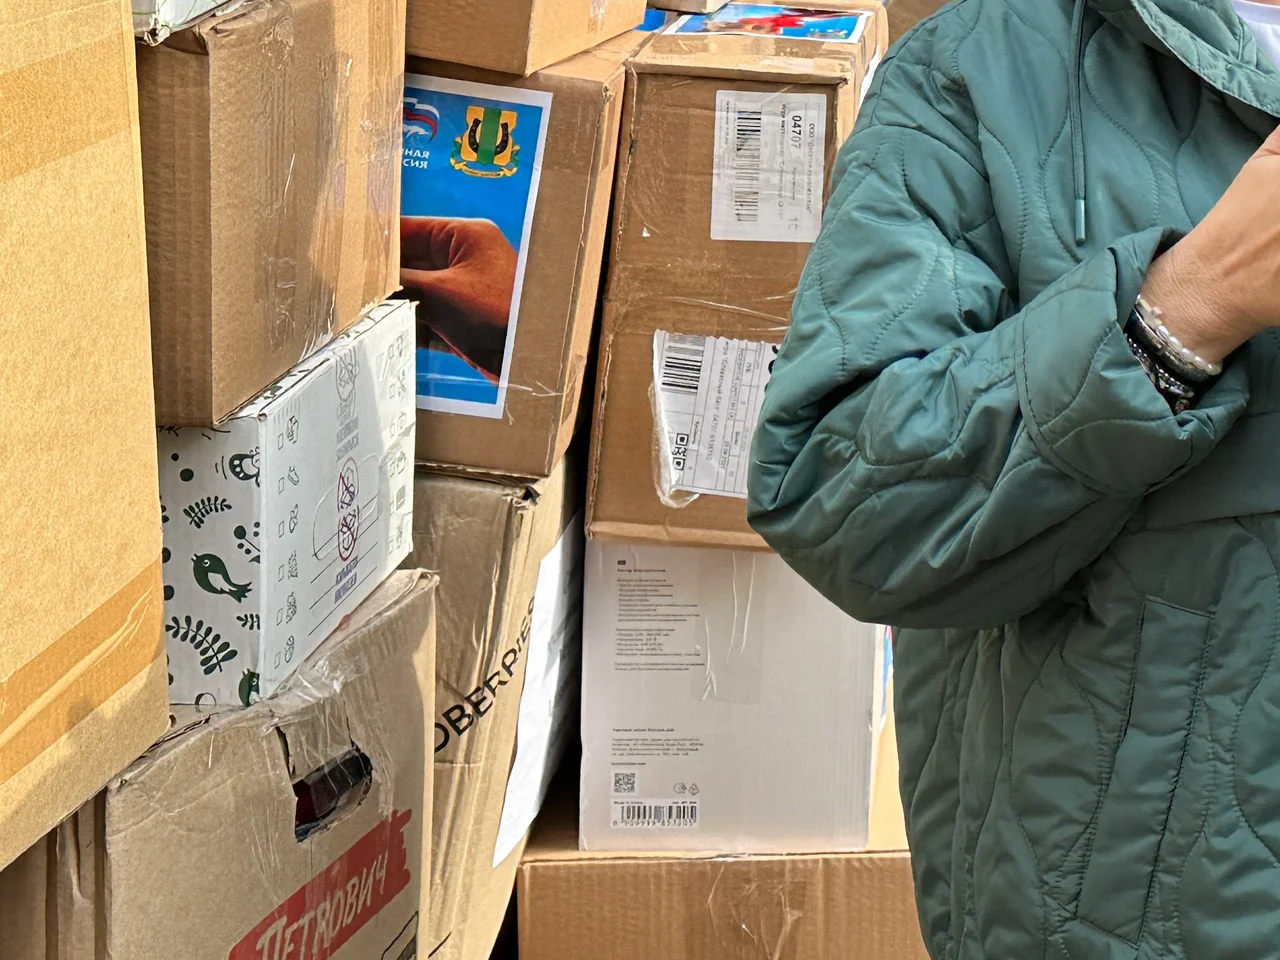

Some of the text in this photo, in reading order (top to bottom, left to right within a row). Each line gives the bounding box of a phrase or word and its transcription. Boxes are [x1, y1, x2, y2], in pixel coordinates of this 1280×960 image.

[790, 115, 802, 149] 04707
[403, 148, 430, 159] НАЯ
[256, 854, 388, 960] ПЕТРОВИЧ
